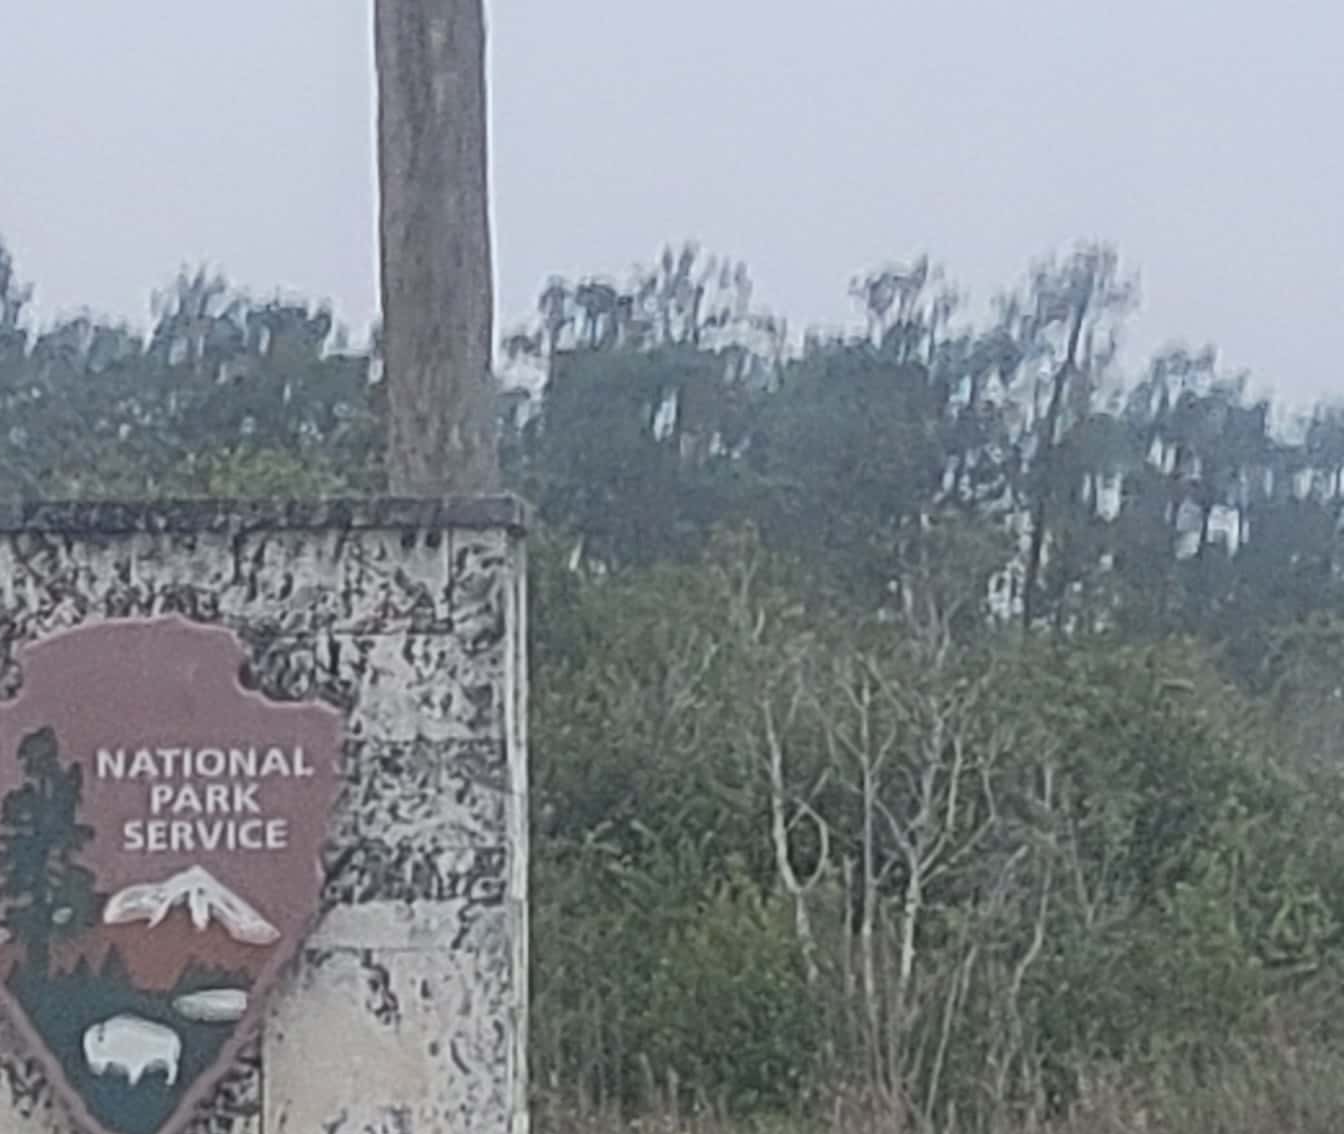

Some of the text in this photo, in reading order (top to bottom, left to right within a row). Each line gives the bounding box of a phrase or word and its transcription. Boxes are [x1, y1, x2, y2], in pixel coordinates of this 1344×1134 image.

[96, 747, 314, 778] NATIONAL
[150, 783, 261, 814] PARK
[122, 819, 288, 850] SERVICE
